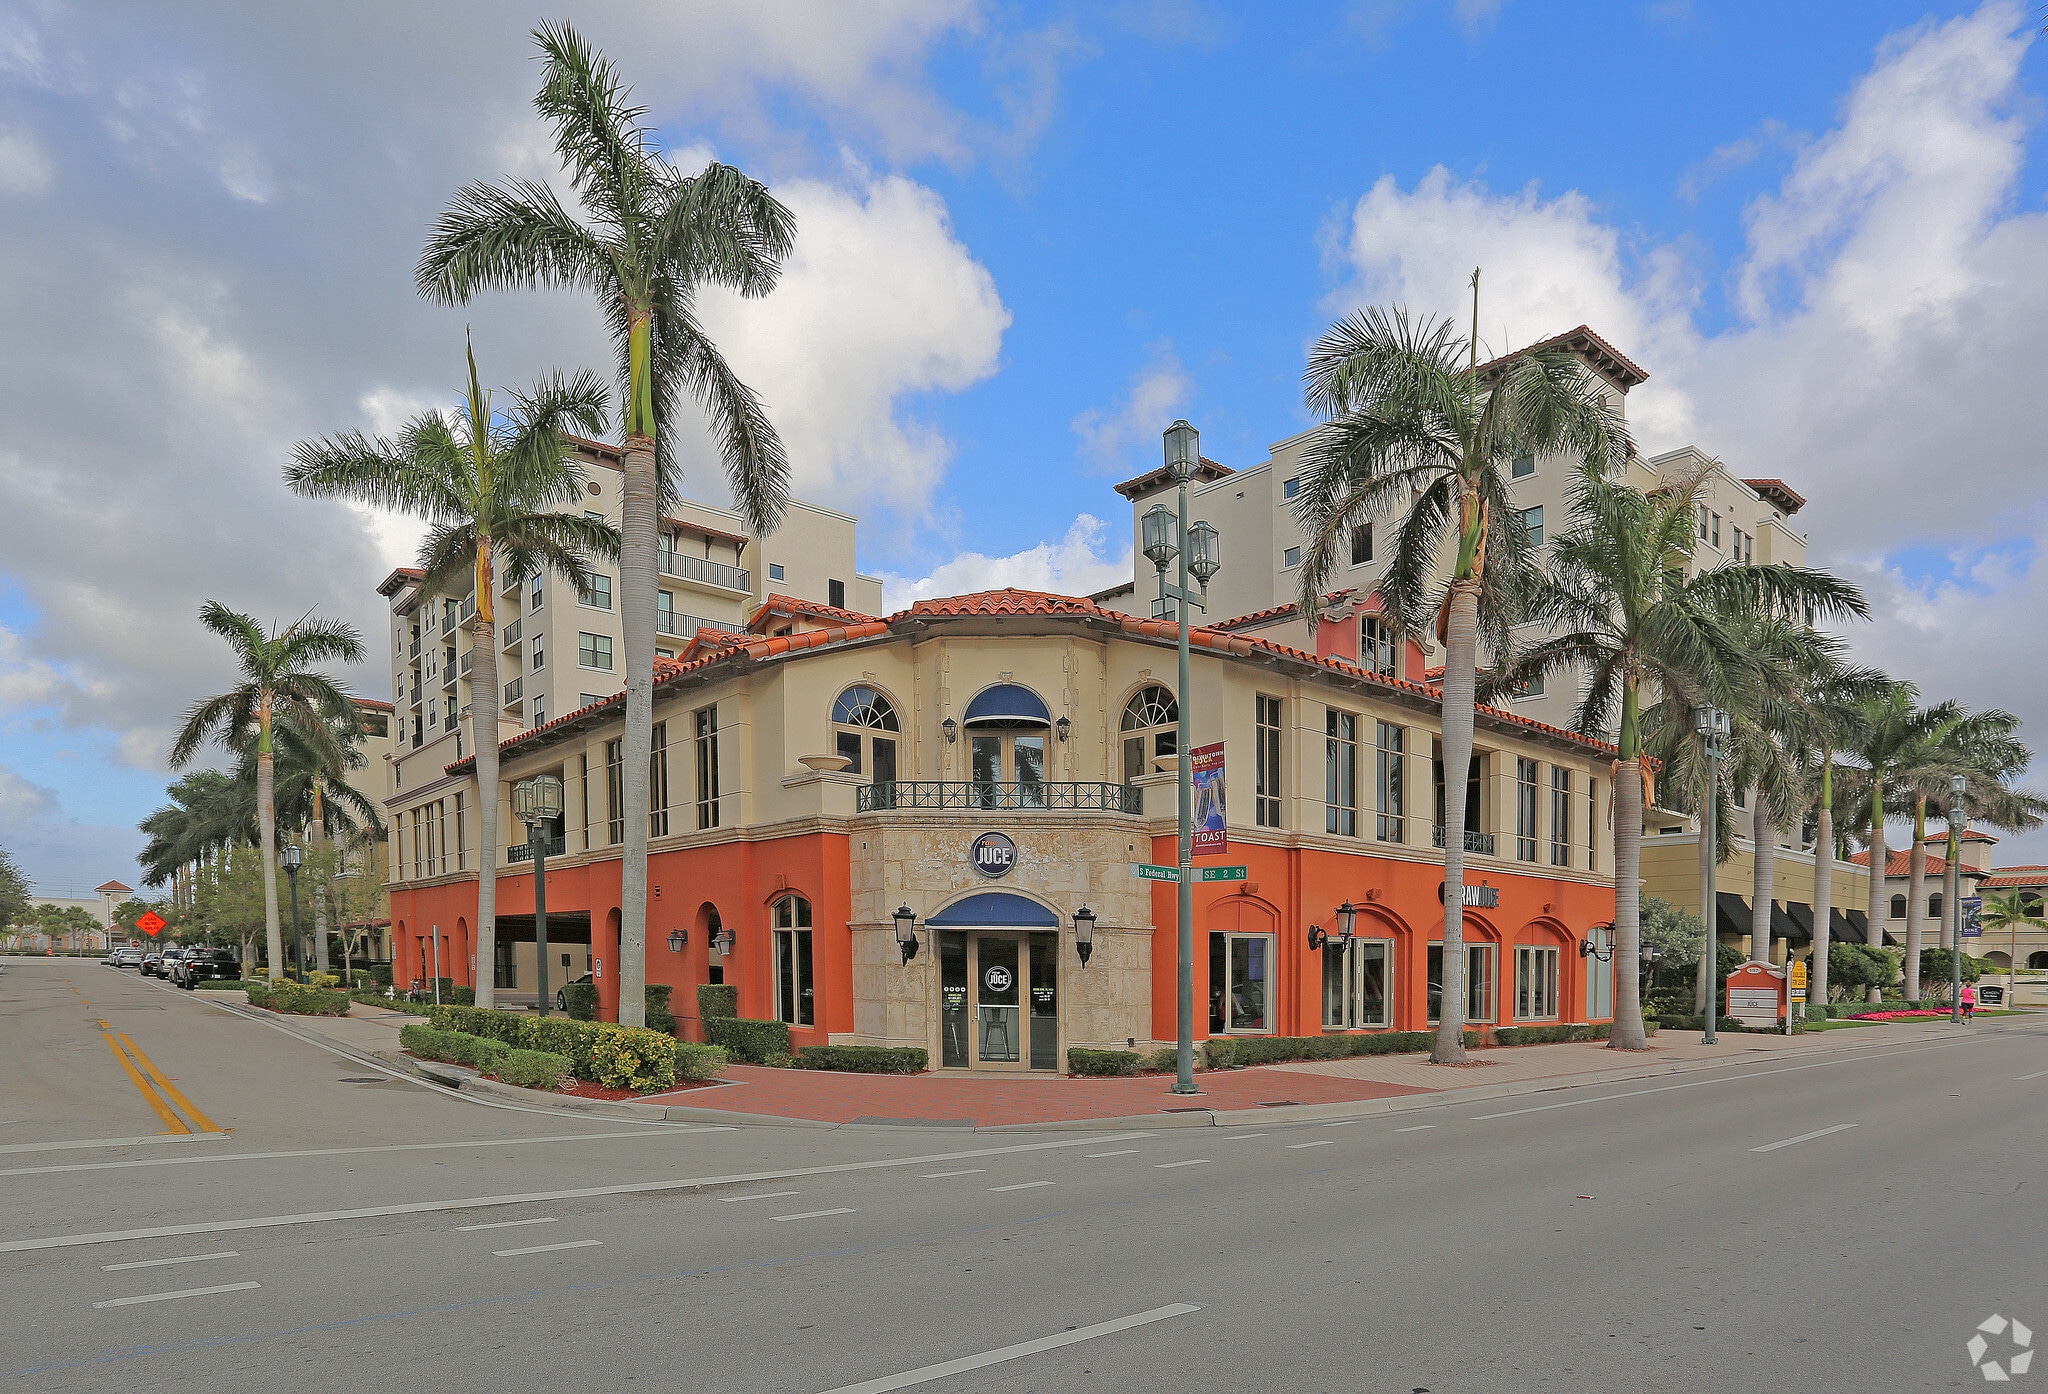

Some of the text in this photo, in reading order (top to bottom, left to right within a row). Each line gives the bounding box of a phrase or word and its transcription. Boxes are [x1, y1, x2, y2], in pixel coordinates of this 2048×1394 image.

[1195, 831, 1225, 842] TOAST
[977, 847, 1010, 865] JUCE
[1139, 868, 1180, 881] S Federal Hwy
[1204, 869, 1245, 879] SE 2 St
